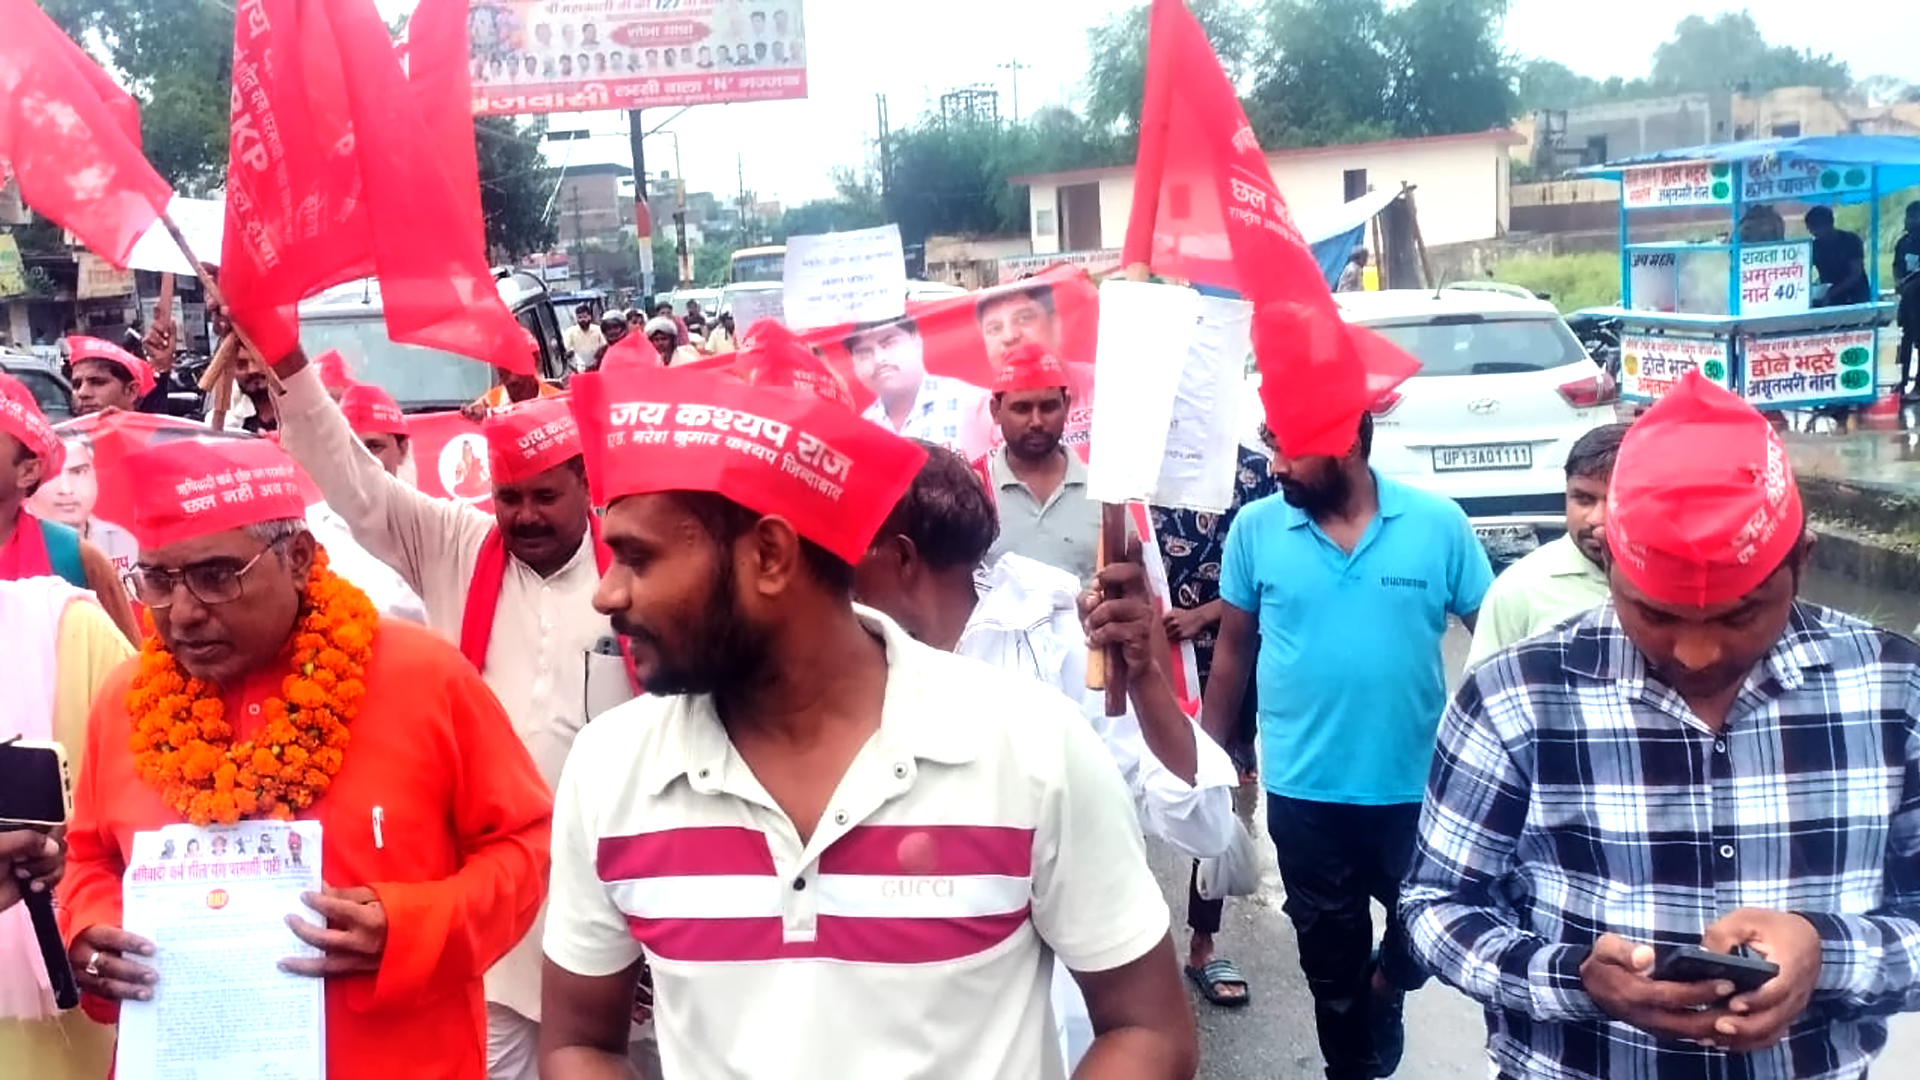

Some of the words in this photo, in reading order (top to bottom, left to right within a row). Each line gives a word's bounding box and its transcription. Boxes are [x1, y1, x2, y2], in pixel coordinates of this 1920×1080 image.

[1742, 287, 1771, 303] नान
[609, 401, 672, 426] जय
[674, 403, 792, 449] कश्यप
[796, 431, 854, 483] राज
[673, 430, 722, 448] कुमार
[725, 434, 779, 465] कश्यप
[880, 878, 955, 899] GUCCI
